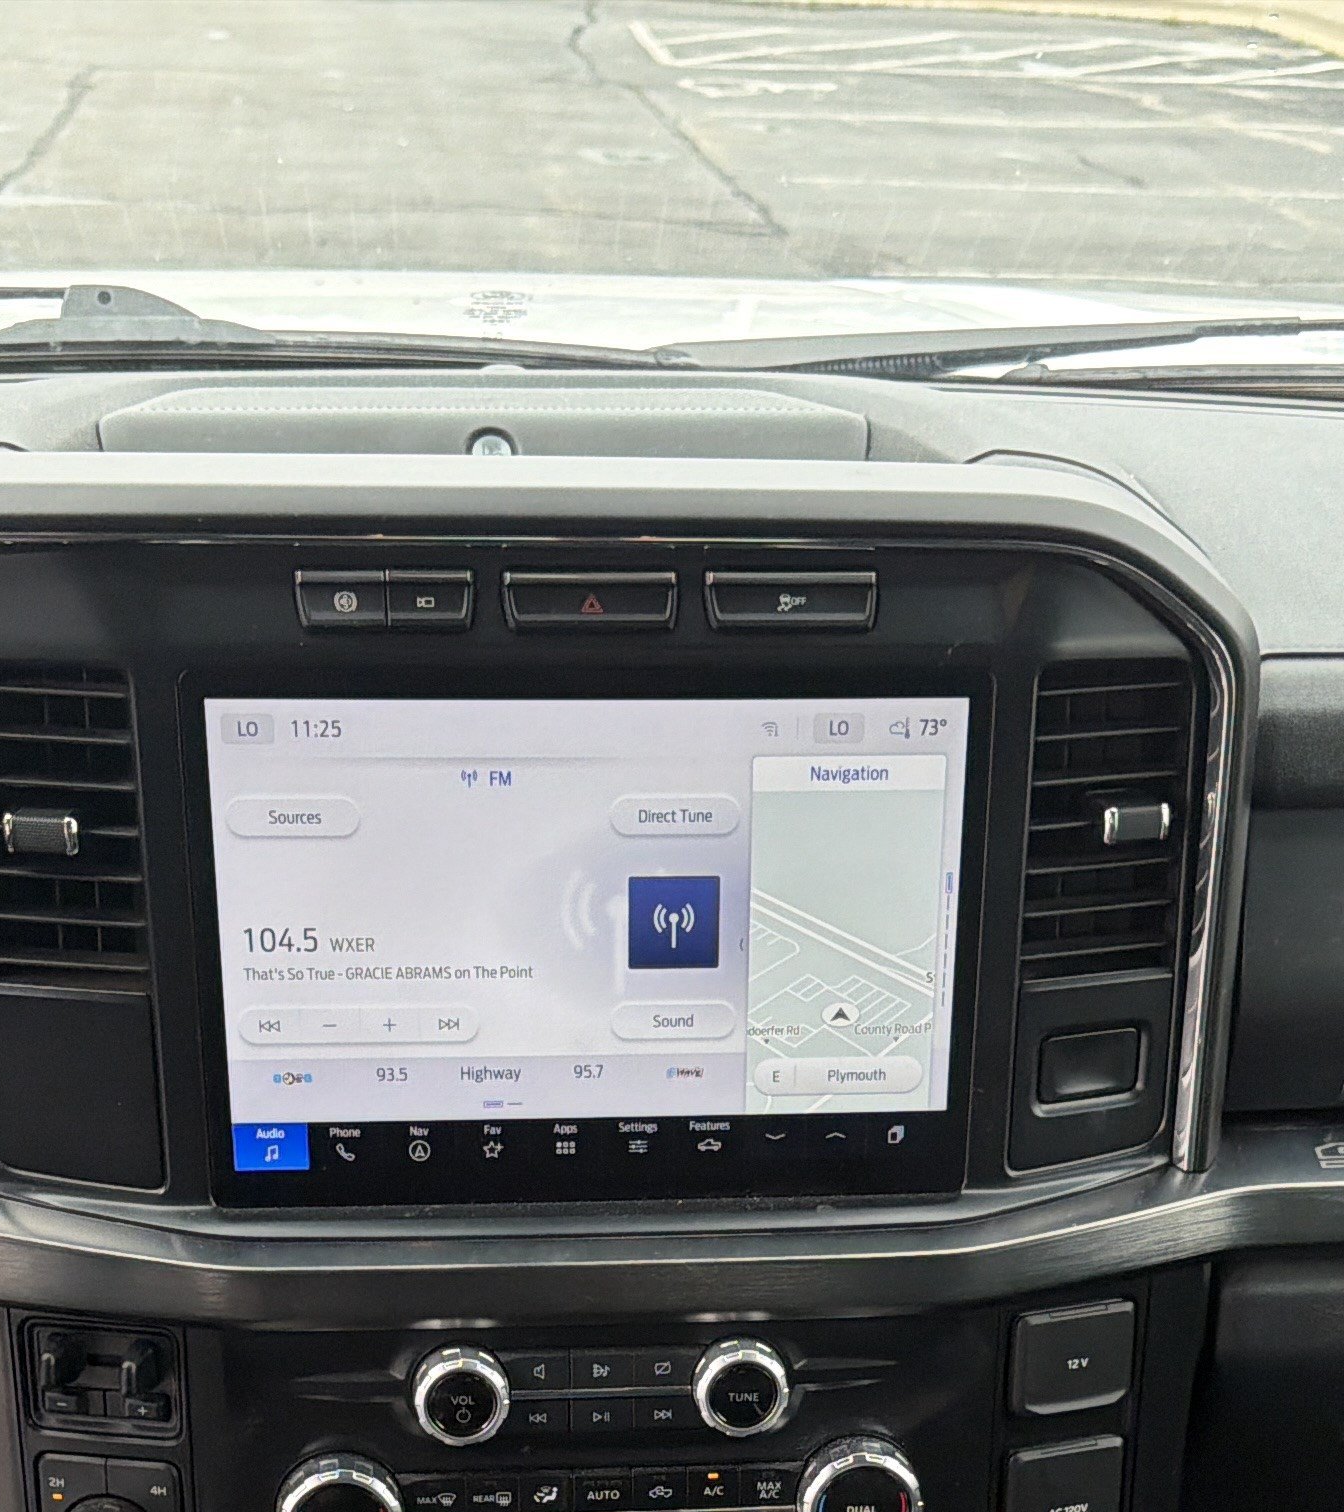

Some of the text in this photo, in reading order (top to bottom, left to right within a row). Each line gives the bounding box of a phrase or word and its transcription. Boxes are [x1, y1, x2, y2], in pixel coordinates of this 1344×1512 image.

[790, 596, 807, 606] OFF
[237, 720, 259, 738] LO
[291, 719, 342, 738] 11:25
[828, 719, 850, 737] LO
[918, 718, 948, 737] 73°
[489, 771, 512, 786] FM
[810, 765, 889, 784] Navigation
[268, 810, 322, 826] Sources
[638, 808, 713, 824] Direct Tune
[242, 927, 375, 953] 104.5 WXER
[243, 967, 285, 982] That's
[287, 967, 304, 982] So
[306, 967, 335, 981] True
[345, 966, 393, 981] GRACIE
[396, 966, 452, 980] ABRAMS
[454, 968, 470, 979] on
[473, 966, 498, 979] The
[500, 965, 533, 979] Point
[652, 1014, 694, 1029] Sound
[786, 1025, 800, 1036] Rd
[854, 1022, 932, 1038] County Road P
[376, 1067, 408, 1082] 93.5
[460, 1065, 522, 1083] Highway
[573, 1064, 604, 1079] 95.7
[771, 1071, 781, 1083] E
[827, 1068, 887, 1084] Plymouth
[329, 1126, 361, 1139] Phone
[409, 1125, 429, 1137] Nav
[483, 1124, 502, 1136] Fav
[553, 1123, 578, 1137] Apps
[618, 1120, 658, 1134] Settings
[688, 1119, 731, 1132] Features
[256, 1127, 285, 1140] Audio
[451, 1396, 475, 1406] VOL
[728, 1391, 760, 1403] TUNE
[48, 1476, 66, 1488] 2H
[757, 1480, 782, 1491] MAX
[149, 1485, 168, 1497] 4H
[586, 1489, 621, 1501] AUTO
[703, 1485, 725, 1496] A/C
[759, 1490, 780, 1500] A/C
[472, 1494, 495, 1503] REAR
